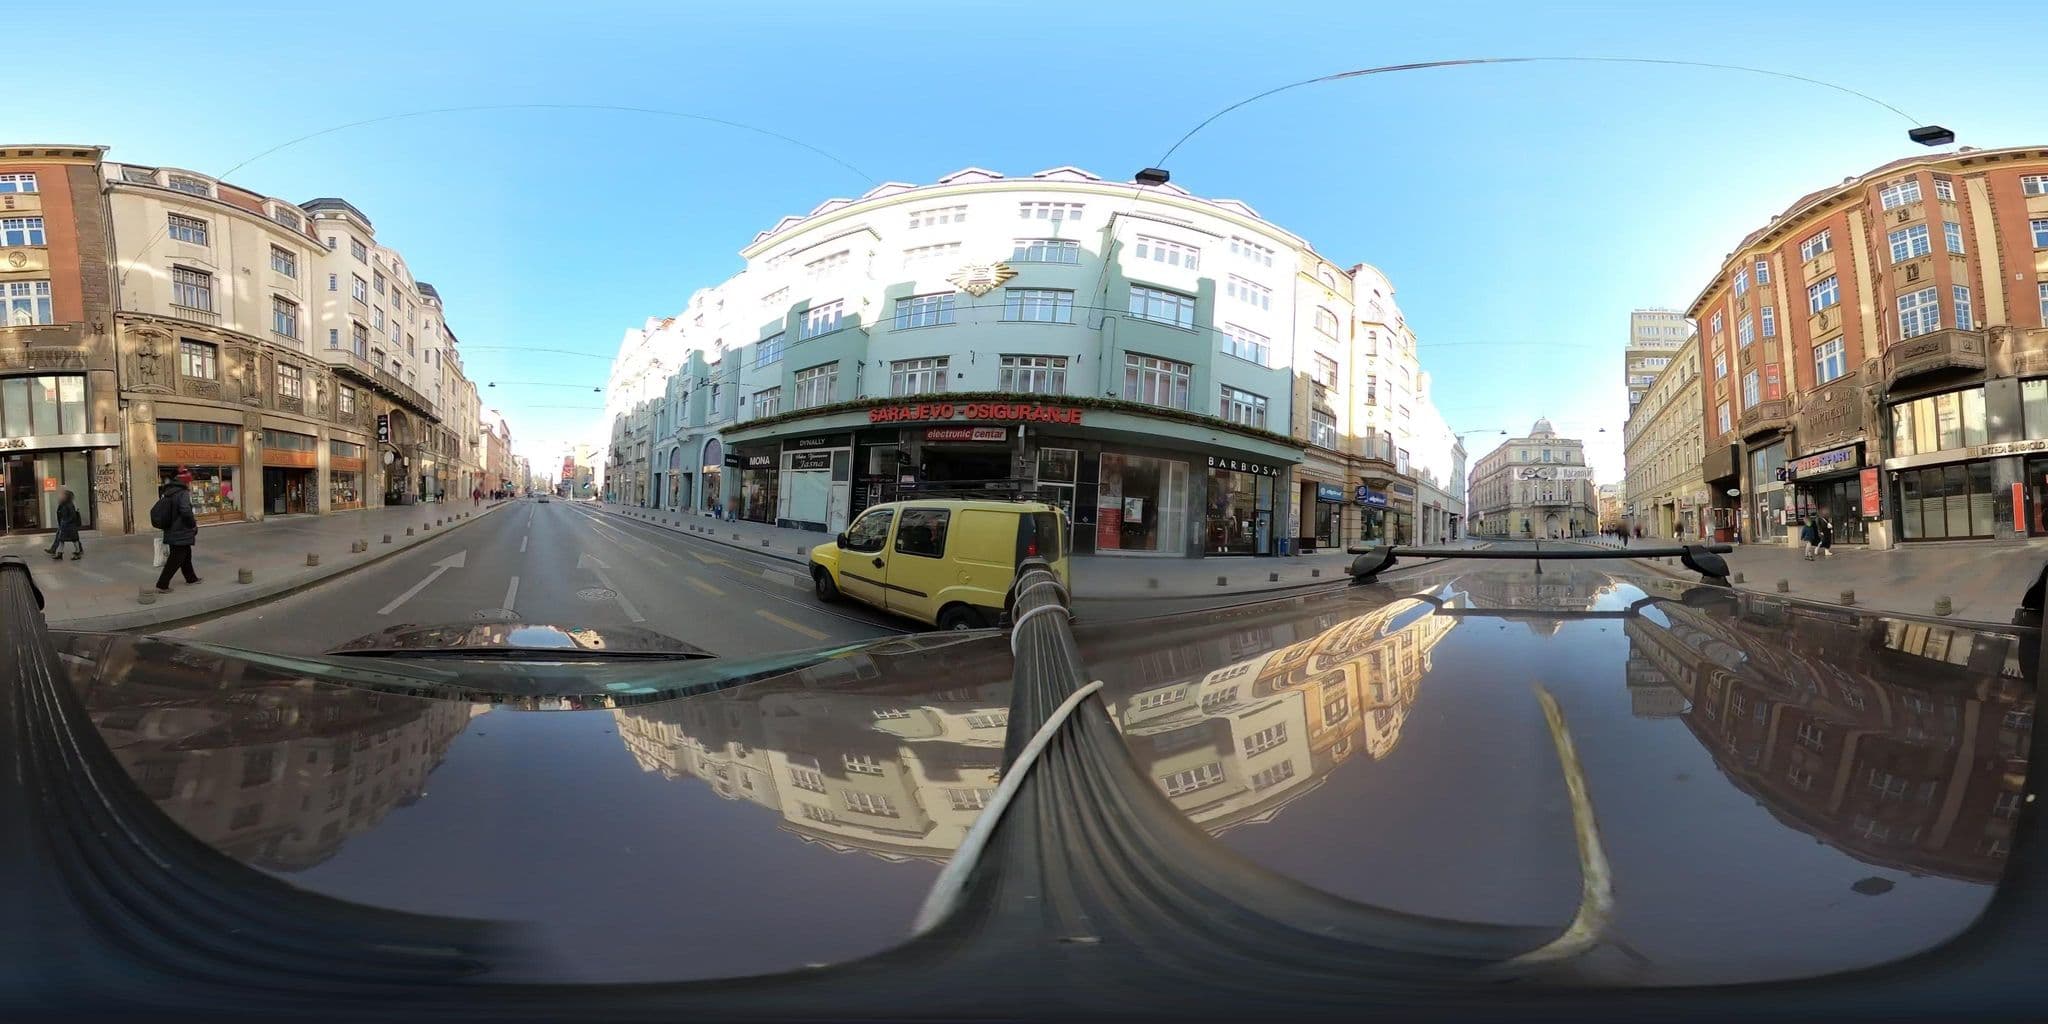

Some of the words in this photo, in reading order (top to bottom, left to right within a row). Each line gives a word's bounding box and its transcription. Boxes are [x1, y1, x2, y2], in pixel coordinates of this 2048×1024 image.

[869, 403, 954, 422] SARAJEVO
[964, 404, 1082, 424] OSIGURANJE
[928, 429, 970, 438] electronic
[974, 429, 1003, 438] centar
[749, 455, 770, 465] MONA
[1208, 456, 1278, 477] BARBOSA
